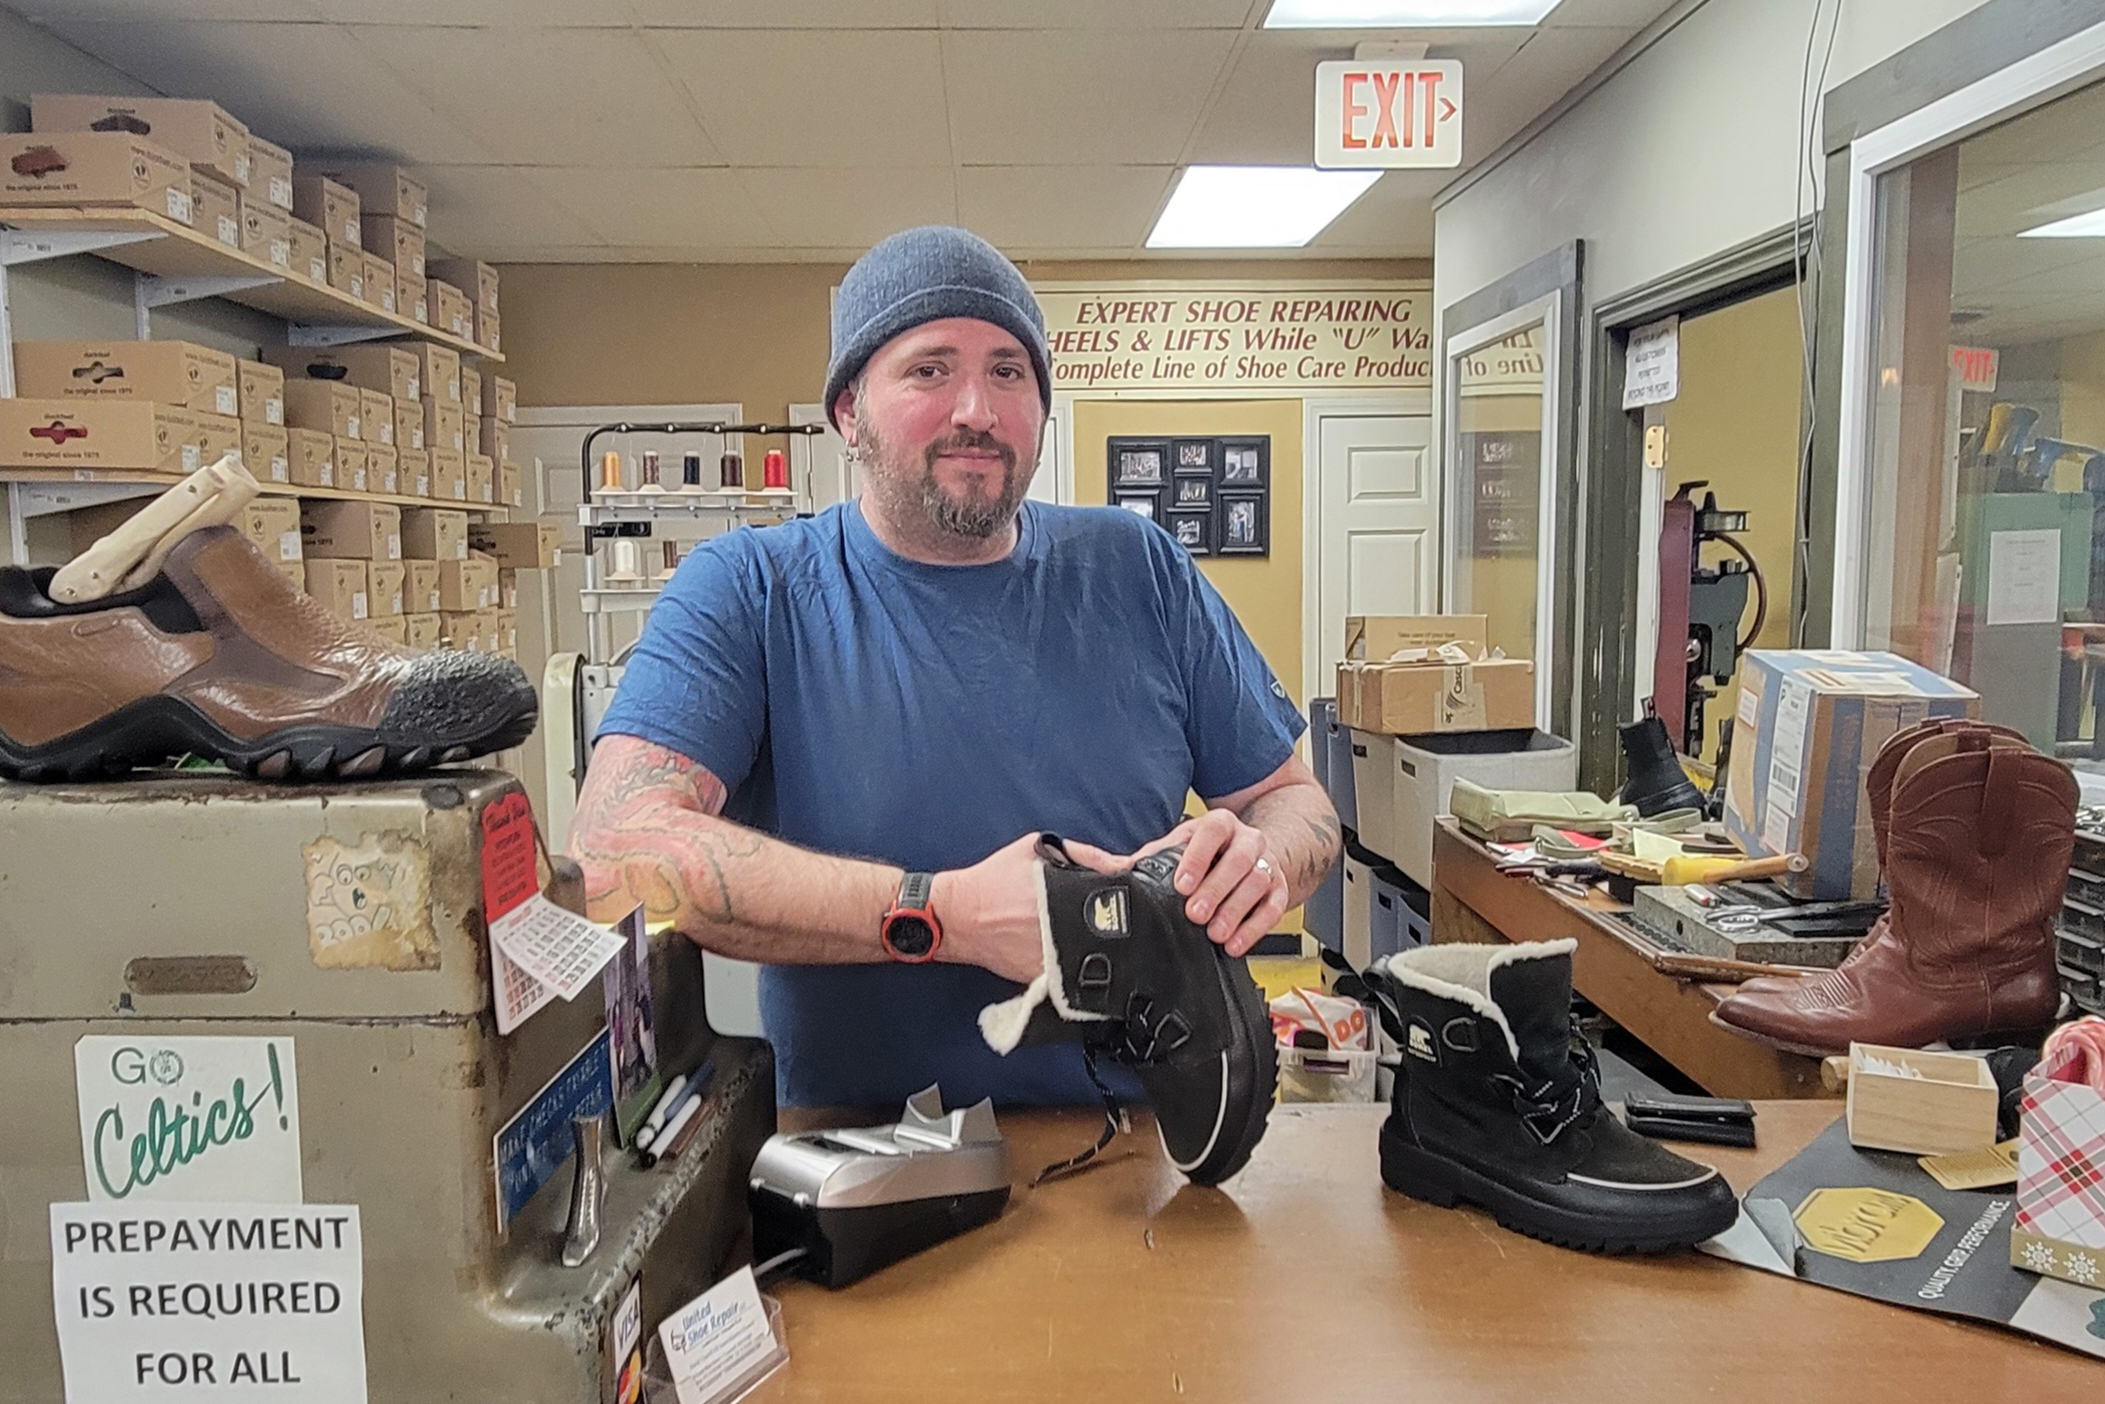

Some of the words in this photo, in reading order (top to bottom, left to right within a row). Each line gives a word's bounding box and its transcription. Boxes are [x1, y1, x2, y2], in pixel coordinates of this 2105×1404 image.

[1342, 72, 1443, 149] EXIT
[1076, 300, 1177, 325] EXPERT
[1185, 299, 1260, 323] SHOE
[1269, 299, 1413, 323] REPAIRING
[1131, 329, 1153, 352] &
[1163, 329, 1231, 351] LIFTS
[1244, 327, 1317, 351] While
[1392, 327, 1434, 350] Wa
[1051, 356, 1143, 386] omplete
[1152, 355, 1195, 379] Line
[1205, 355, 1229, 379] of
[1235, 355, 1288, 379] Shoe
[1297, 355, 1347, 379] Care
[1354, 354, 1434, 378] Produc
[65, 1217, 349, 1253] PREPAYMENT
[79, 1286, 115, 1318] IS
[129, 1282, 341, 1320] REQUIRED
[682, 1301, 711, 1332] United
[687, 1323, 708, 1347] Shoe
[709, 1302, 739, 1332] Repair
[136, 1352, 216, 1385] FOR
[230, 1351, 301, 1384] ALL
